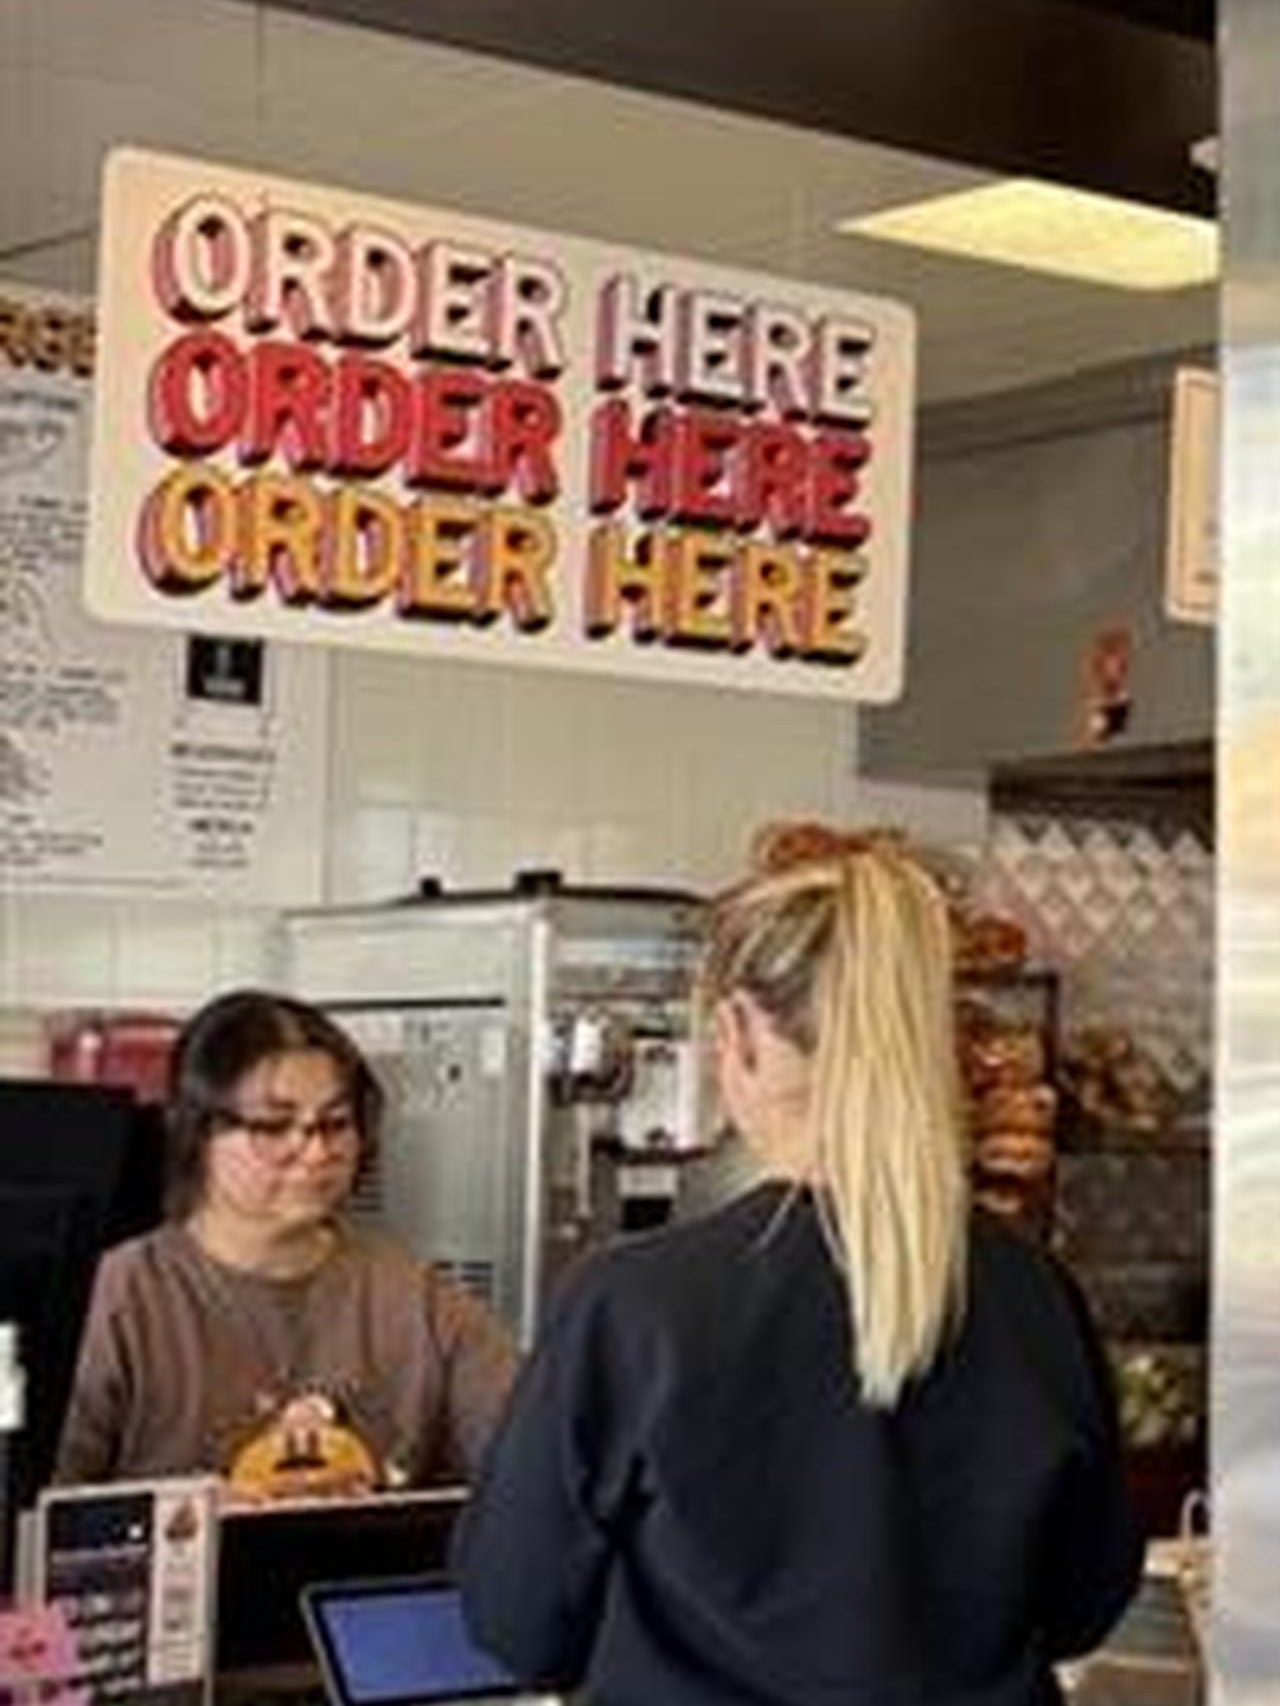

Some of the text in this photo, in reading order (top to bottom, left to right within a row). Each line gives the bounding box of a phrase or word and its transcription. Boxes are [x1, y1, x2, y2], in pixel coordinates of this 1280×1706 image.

[154, 194, 874, 427] ORDER HERE
[148, 331, 872, 547] ORDER HERE
[137, 464, 556, 631] ORDER
[585, 526, 866, 667] HERE
